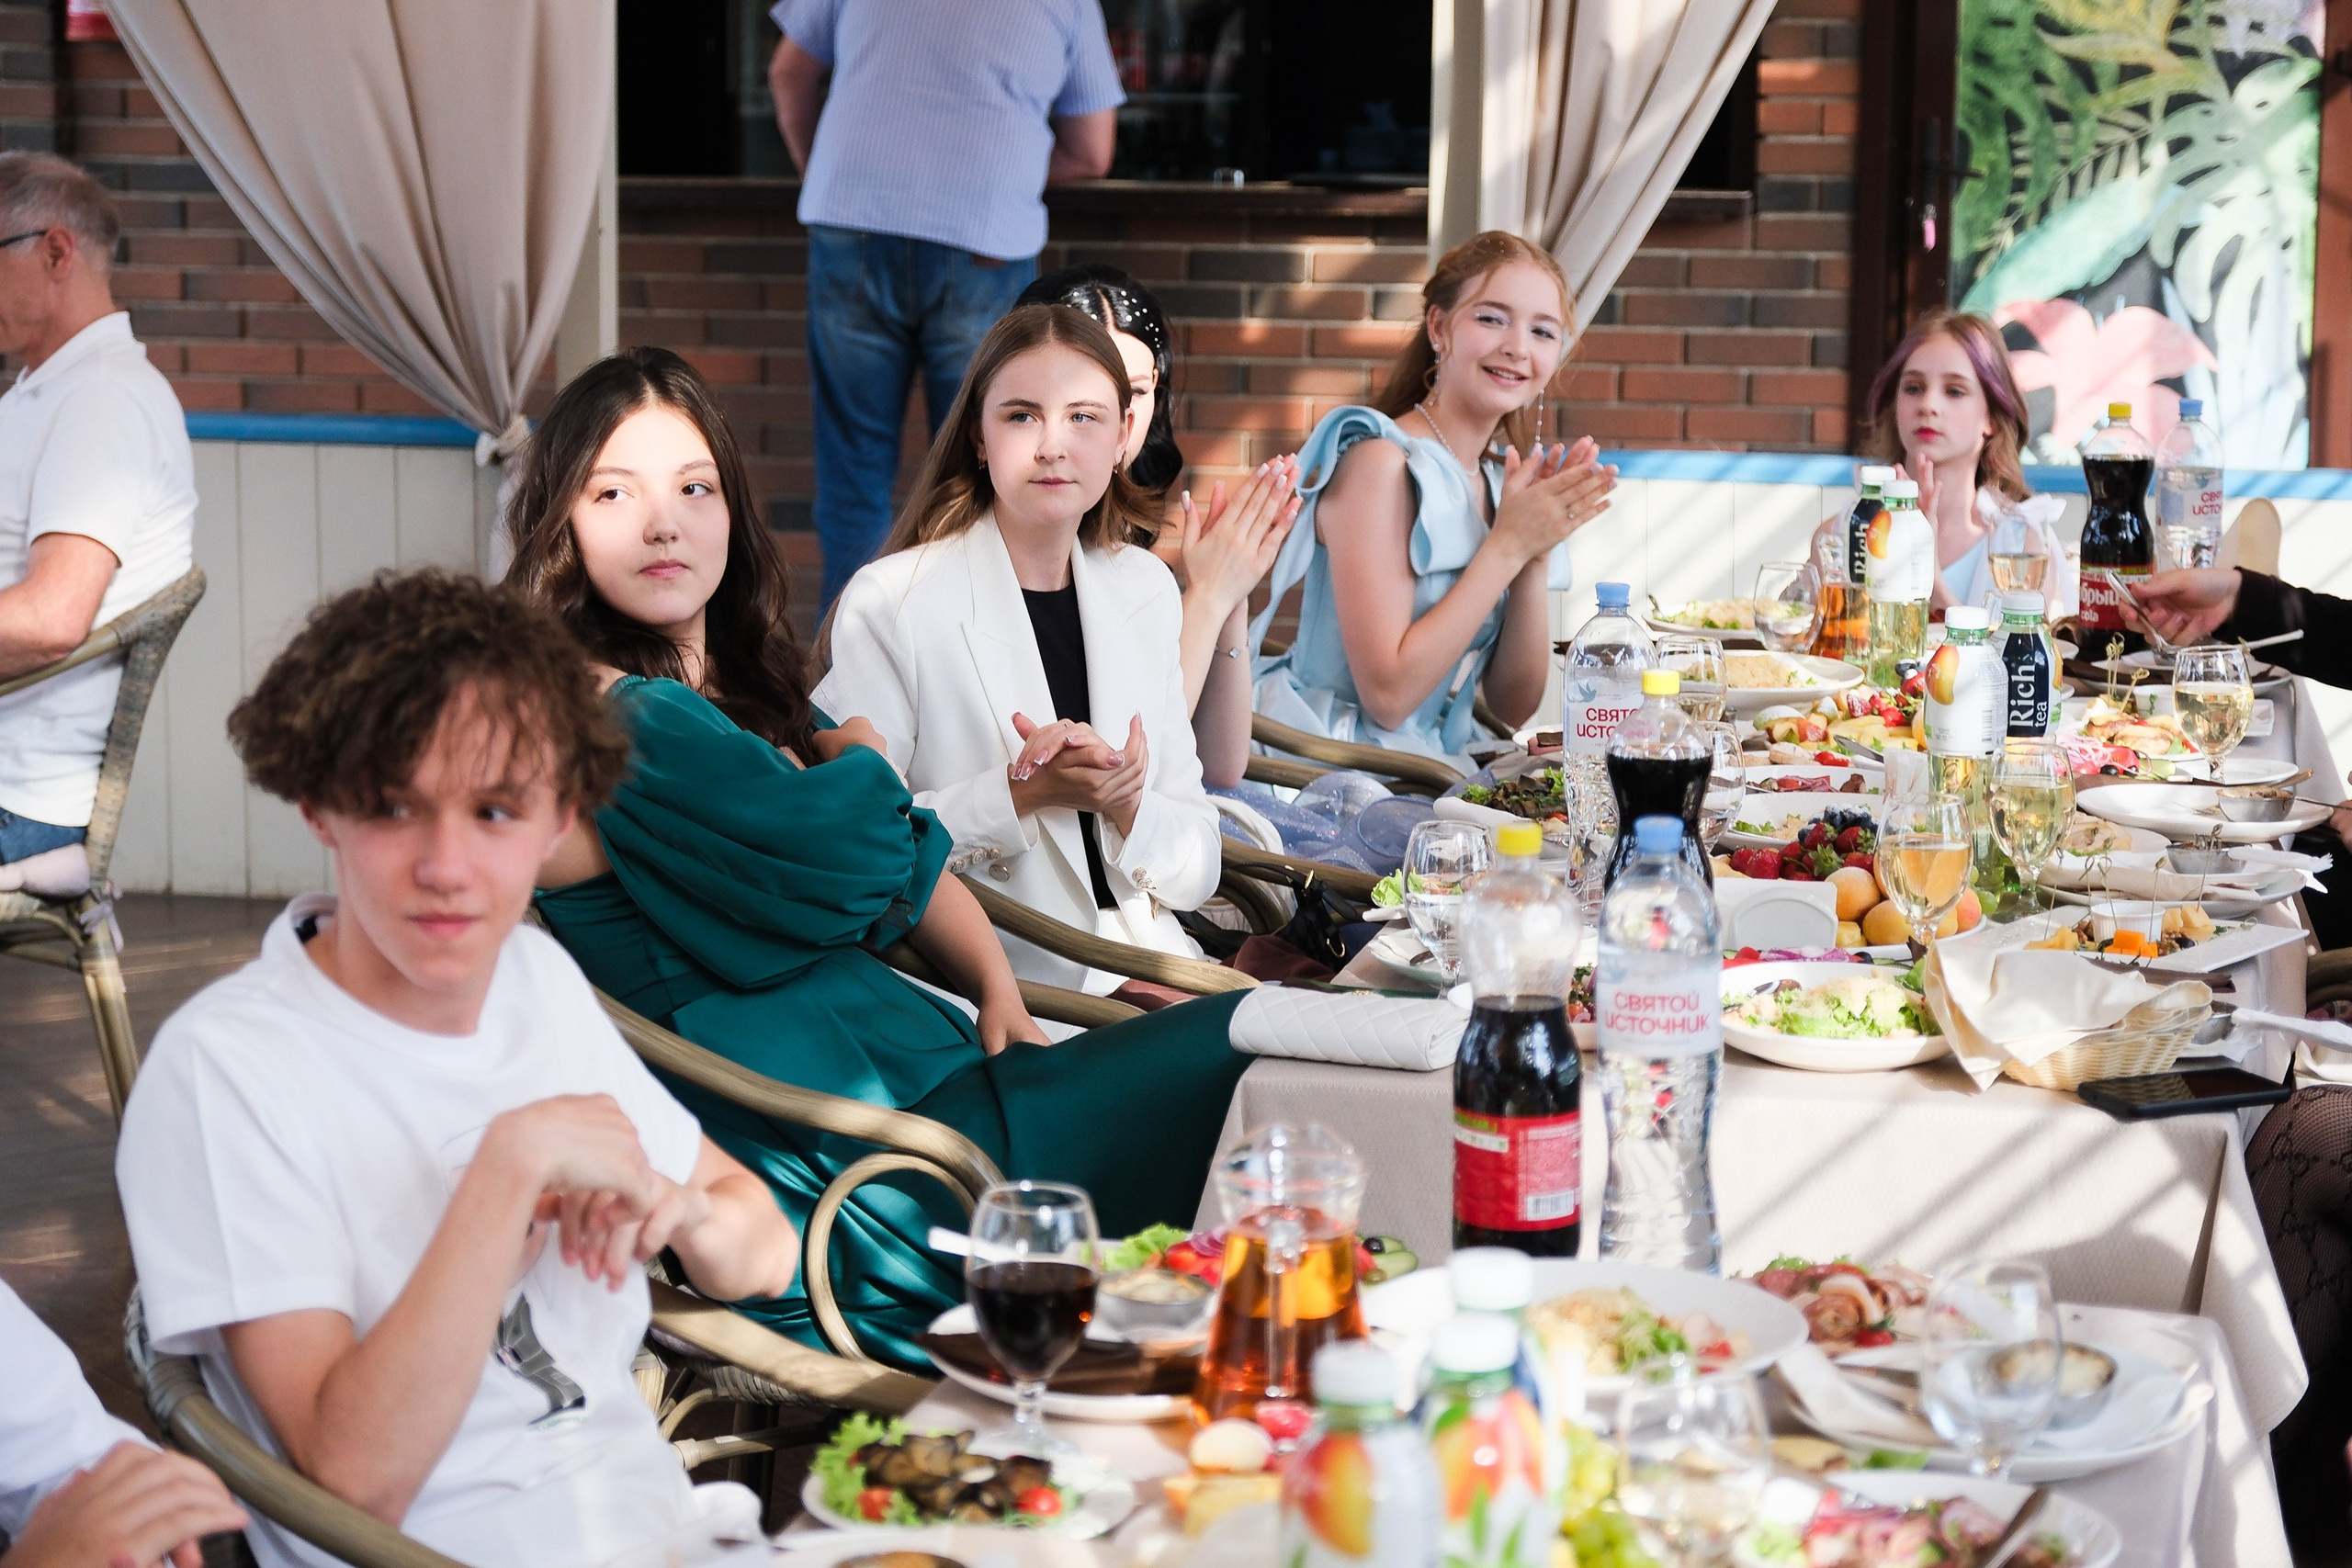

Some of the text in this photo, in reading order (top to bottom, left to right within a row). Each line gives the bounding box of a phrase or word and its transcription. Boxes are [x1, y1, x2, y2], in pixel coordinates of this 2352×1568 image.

[2192, 503, 2222, 515] ИСТО
[2009, 664, 2036, 728] Rich
[1586, 707, 1640, 723] СВЯТ
[2034, 701, 2048, 728] tea
[1614, 991, 1699, 1012] СВЯТОЙ
[1605, 1012, 1709, 1034] ИСТОЧНИК
